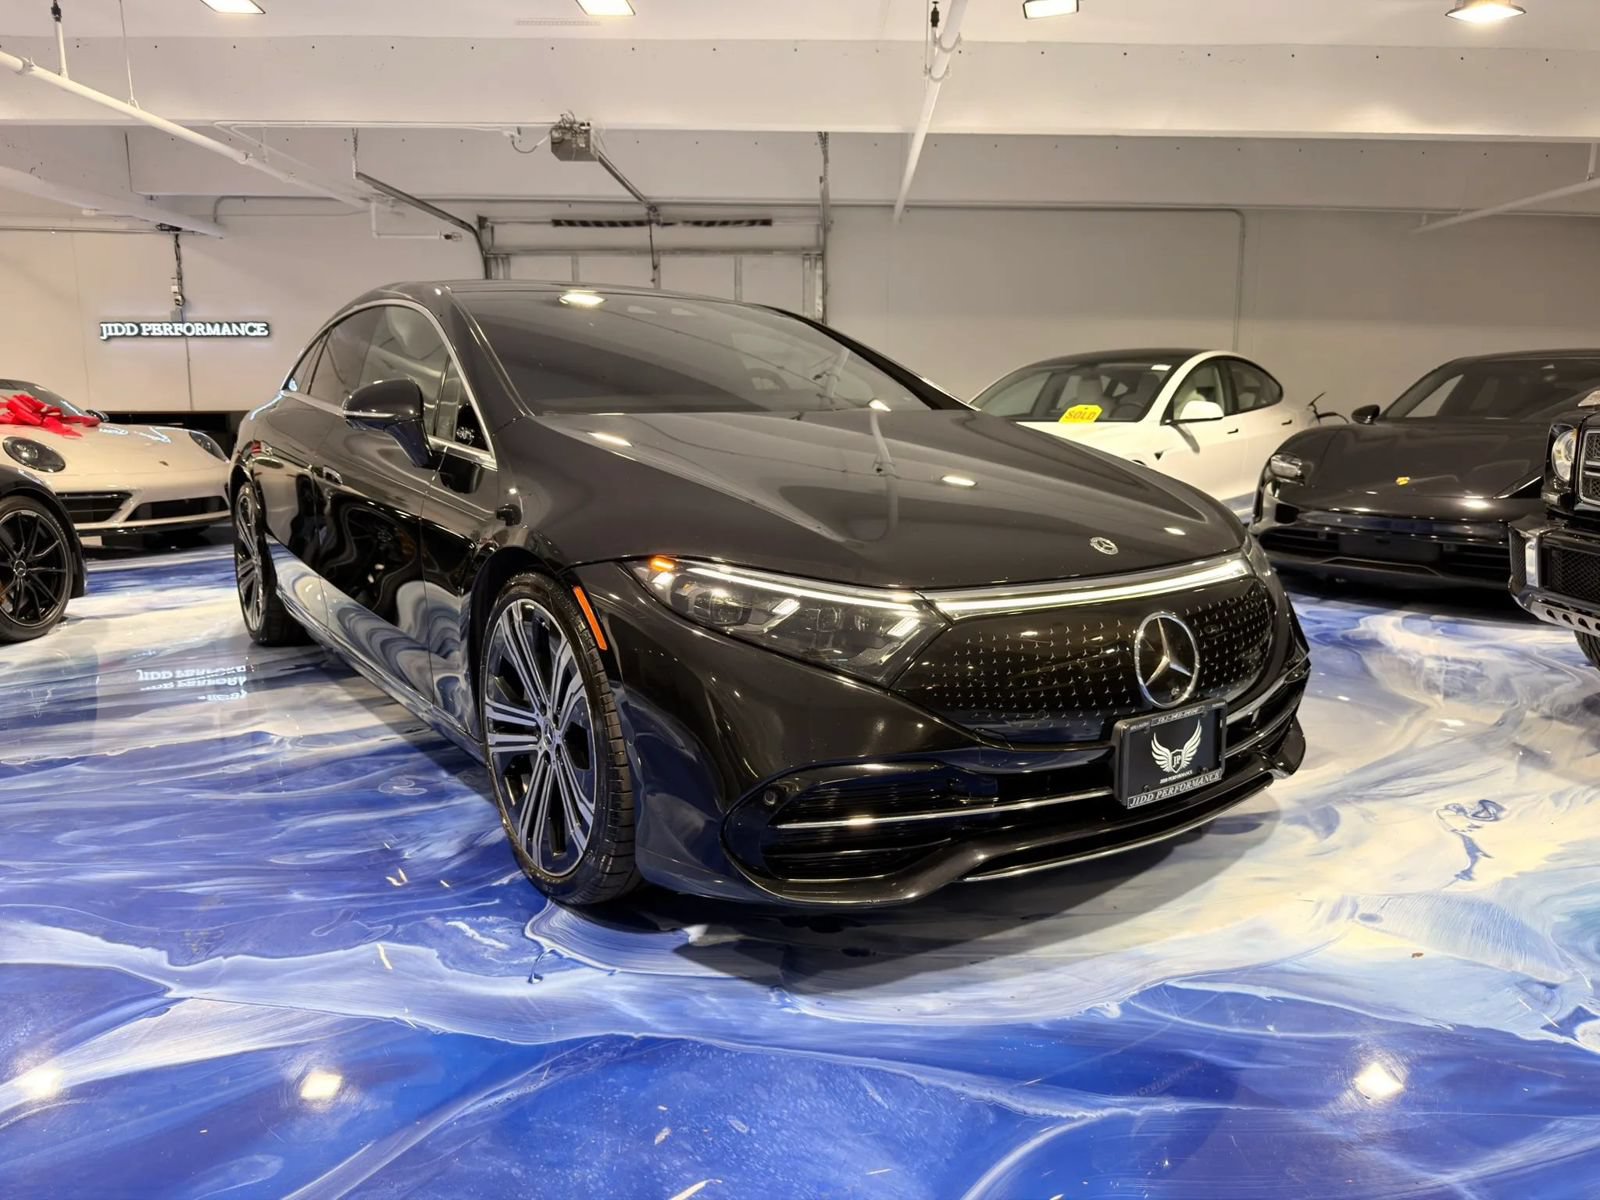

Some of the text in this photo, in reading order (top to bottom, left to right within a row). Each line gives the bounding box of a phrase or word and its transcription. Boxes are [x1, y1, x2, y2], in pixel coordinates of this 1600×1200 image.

[100, 322, 268, 339] JIDD PERFORMANCE
[1065, 411, 1097, 420] SOLD
[1130, 771, 1220, 808] JIDD PERFORMANCE
